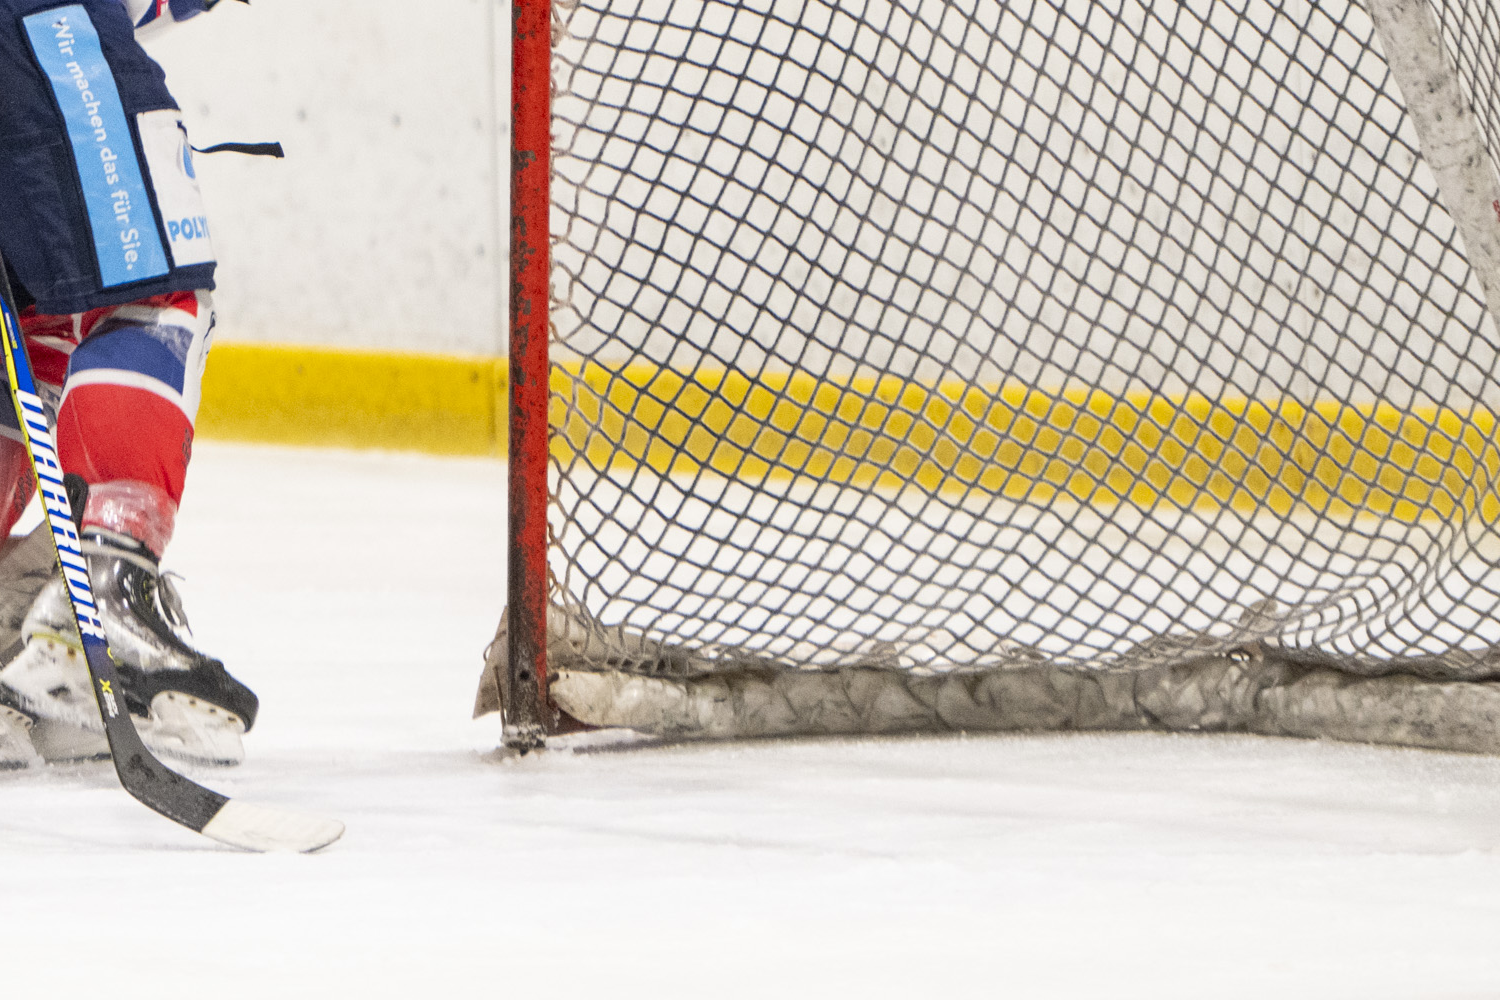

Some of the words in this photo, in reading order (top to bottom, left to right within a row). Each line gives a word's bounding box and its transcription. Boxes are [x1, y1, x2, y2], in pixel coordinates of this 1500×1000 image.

[52, 16, 76, 57] Wir
[66, 61, 107, 142] machen
[100, 147, 120, 185] das
[111, 190, 132, 224] für
[120, 228, 141, 271] Sie.
[15, 389, 106, 641] WARRIOR
